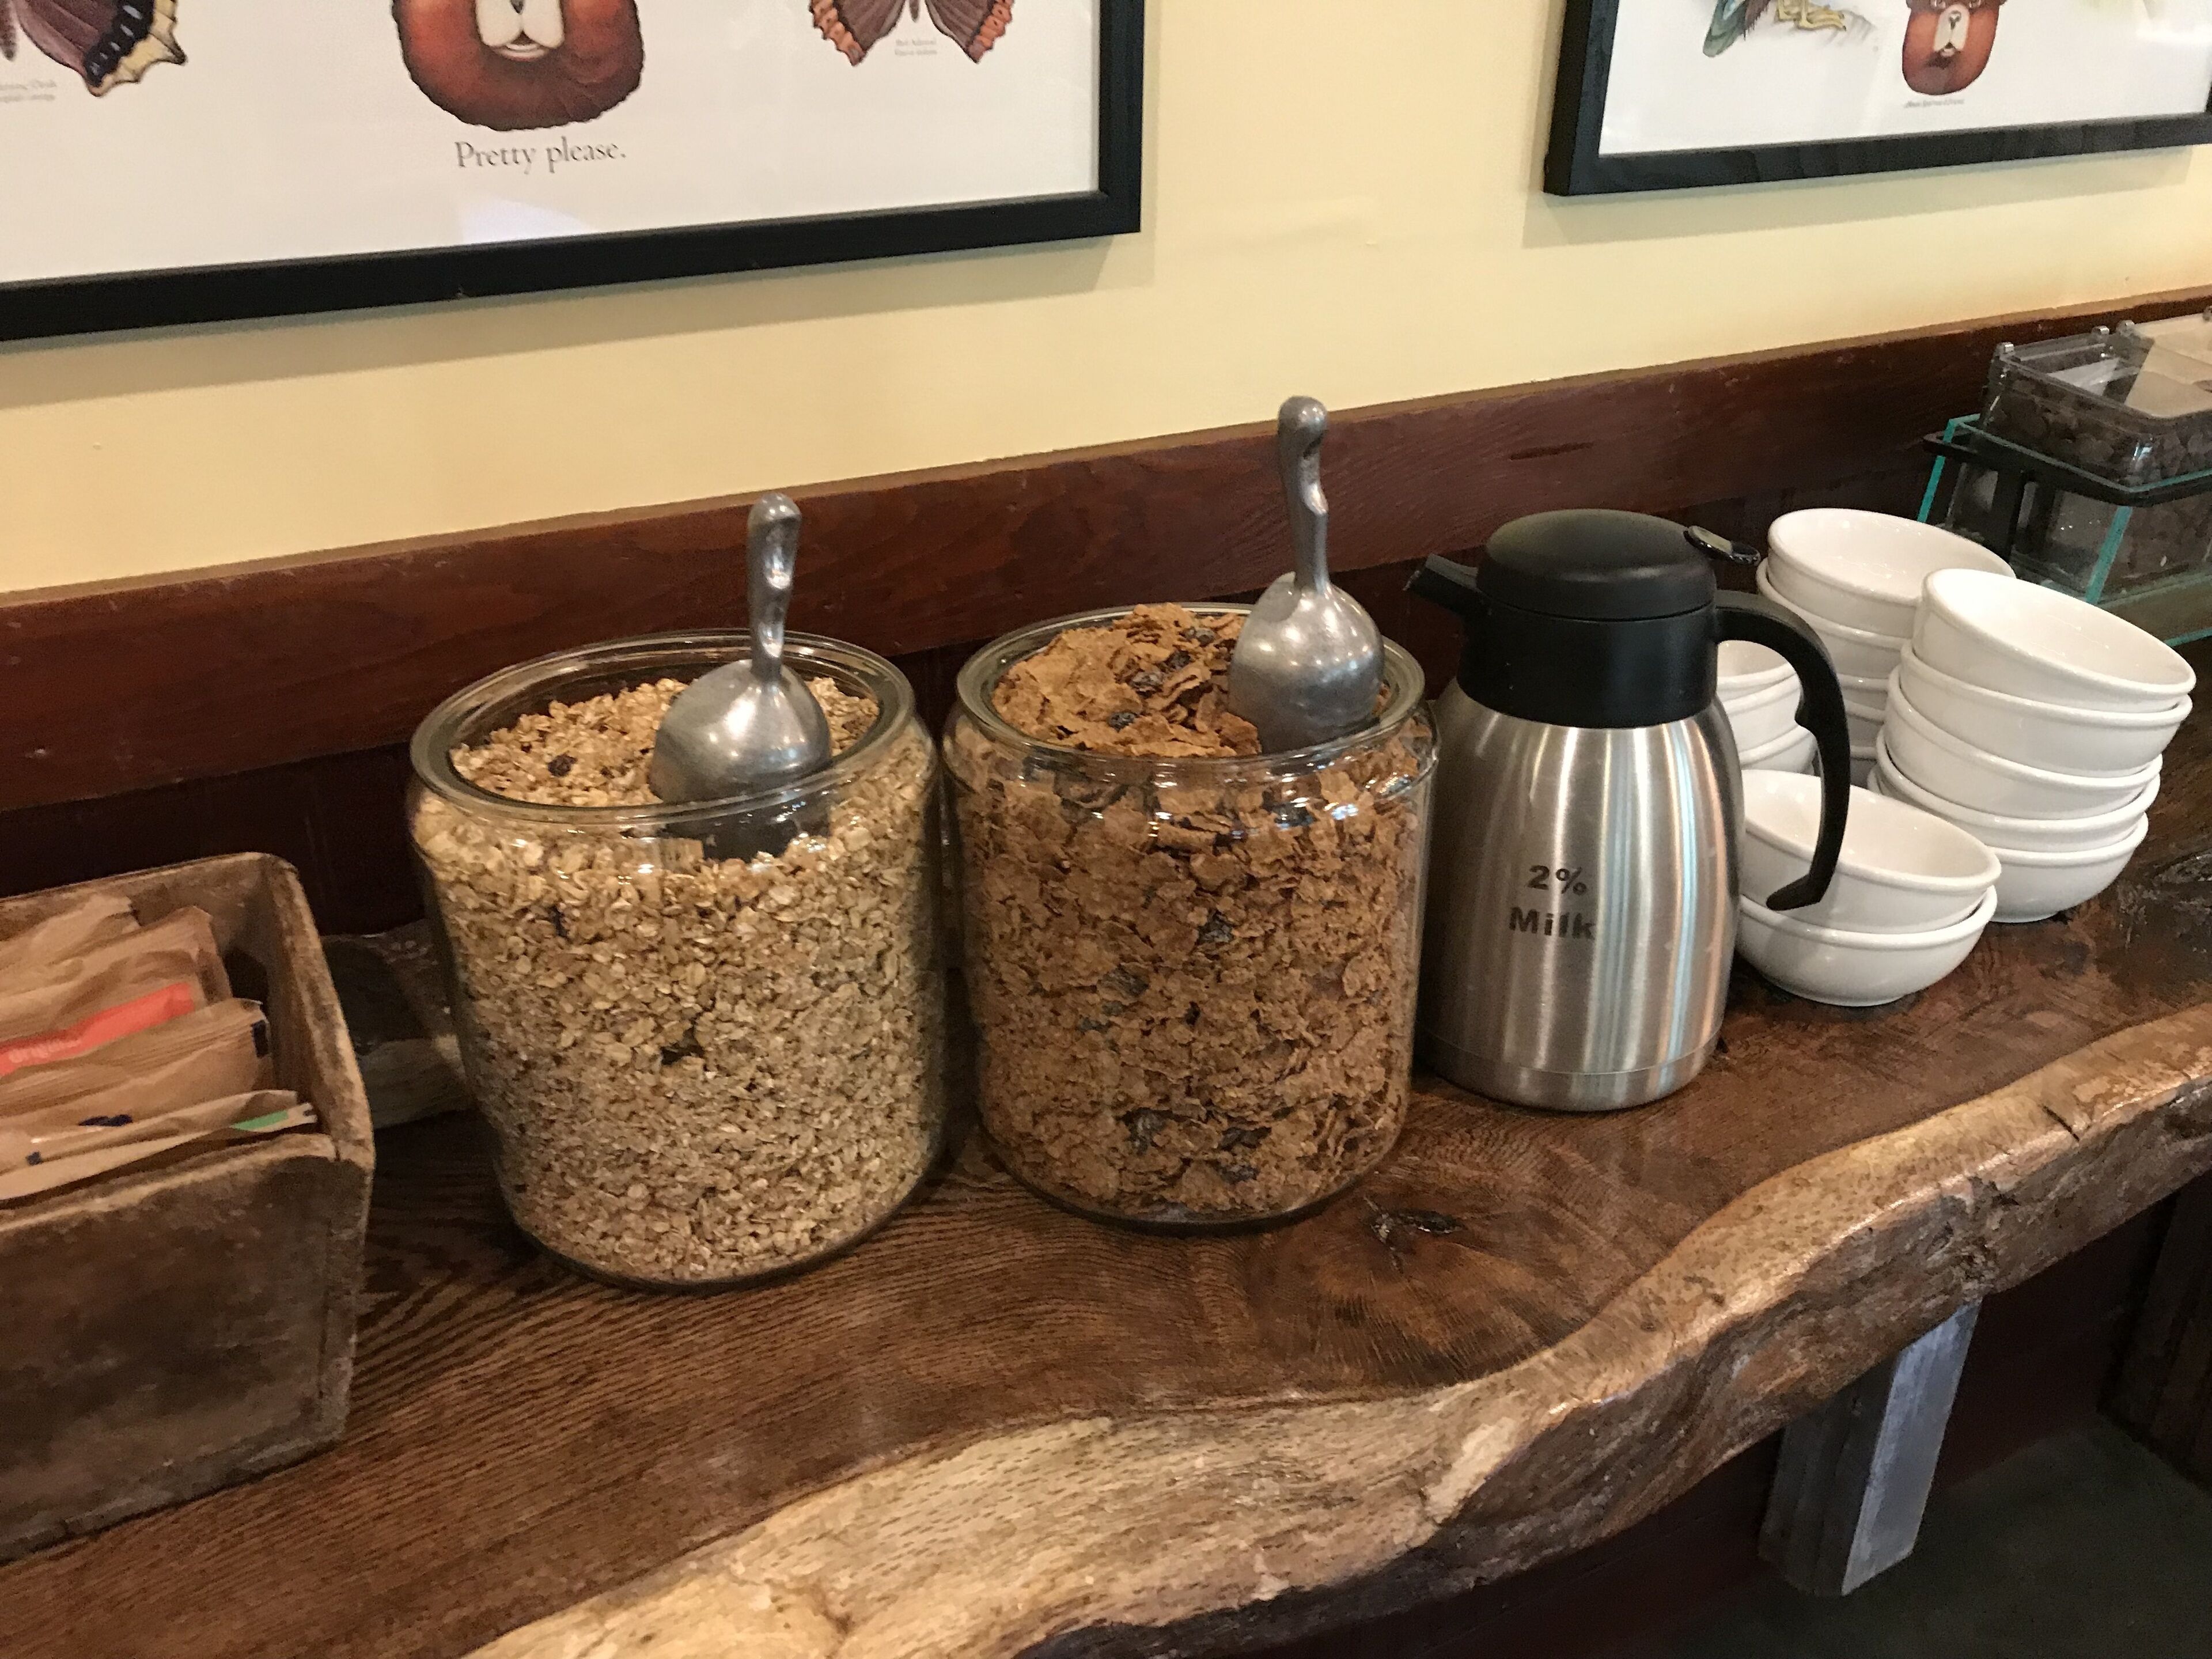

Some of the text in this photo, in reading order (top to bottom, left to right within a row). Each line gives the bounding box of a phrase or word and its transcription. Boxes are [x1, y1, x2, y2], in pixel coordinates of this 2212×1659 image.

[454, 135, 627, 175] Pretty please.
[1527, 865, 1587, 895] 2%
[1509, 906, 1596, 941] Milk
